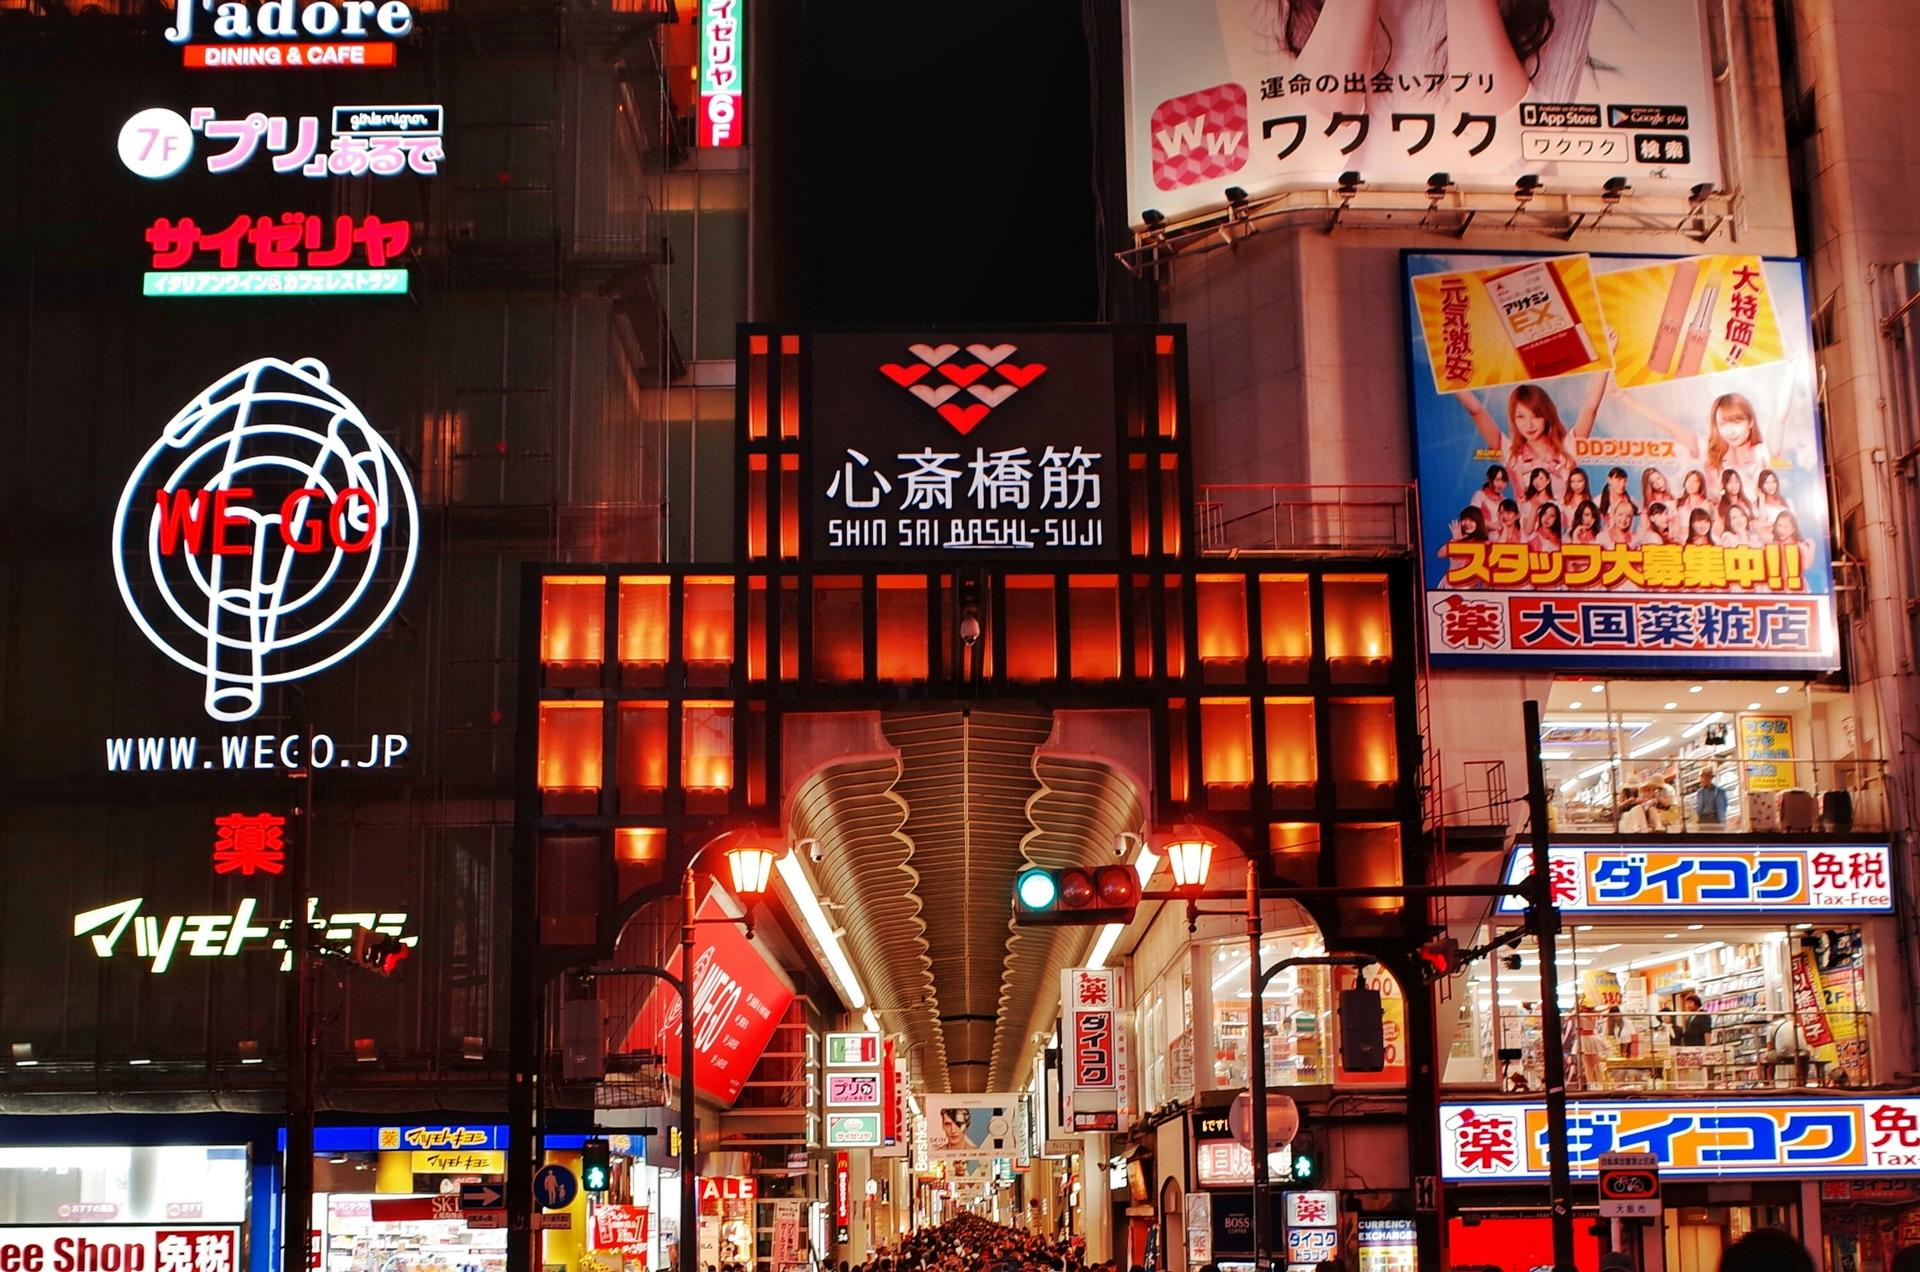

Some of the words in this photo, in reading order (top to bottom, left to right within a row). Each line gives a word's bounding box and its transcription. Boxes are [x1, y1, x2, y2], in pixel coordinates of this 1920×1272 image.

[205, 47, 281, 65] DINING
[286, 47, 302, 64] &
[307, 46, 365, 63] CAFE
[1260, 71, 1494, 101] 運命の出会いアプリ
[708, 94, 735, 147] 6F
[1539, 112, 1565, 126] App
[1566, 112, 1598, 125] Store
[1631, 110, 1665, 126] Google
[1667, 113, 1687, 126] play
[137, 128, 178, 161] 7F
[1262, 111, 1497, 161] ワクワク
[1535, 137, 1615, 156] ワクワク
[1640, 139, 1684, 159] 検索
[145, 212, 411, 269] サイゼリヤ
[1503, 290, 1550, 316] アリナミン
[1508, 302, 1558, 333] EX
[1439, 278, 1474, 383] 元気激安
[1576, 439, 1675, 458] DDプリンセス
[826, 445, 1102, 511] 心斎橋筋
[828, 520, 887, 546] SHIN
[1443, 595, 1503, 649] 薬
[1520, 603, 1810, 648] 大国薬粧店
[213, 813, 285, 875] 薬
[1595, 857, 1801, 900] ダイコク
[1811, 852, 1886, 889] 免税
[1812, 892, 1889, 906] Tax-Free
[74, 898, 419, 973] マツモトヨシ
[1079, 972, 1108, 1005] 薬
[1082, 1014, 1107, 1083] ダイコク
[1459, 1107, 1514, 1171] 薬
[1869, 1104, 1920, 1149] 免
[1873, 1150, 1920, 1165] Tax
[703, 1178, 754, 1199] ALE
[1224, 1217, 1250, 1228] BOSS
[1296, 1194, 1328, 1222] 薬
[1290, 1232, 1336, 1247] ダイコク
[1358, 1220, 1412, 1230] CURRENCY
[1358, 1231, 1413, 1241] EXCHANGE
[54, 1237, 145, 1272] Shop
[158, 1235, 230, 1272] 免税
